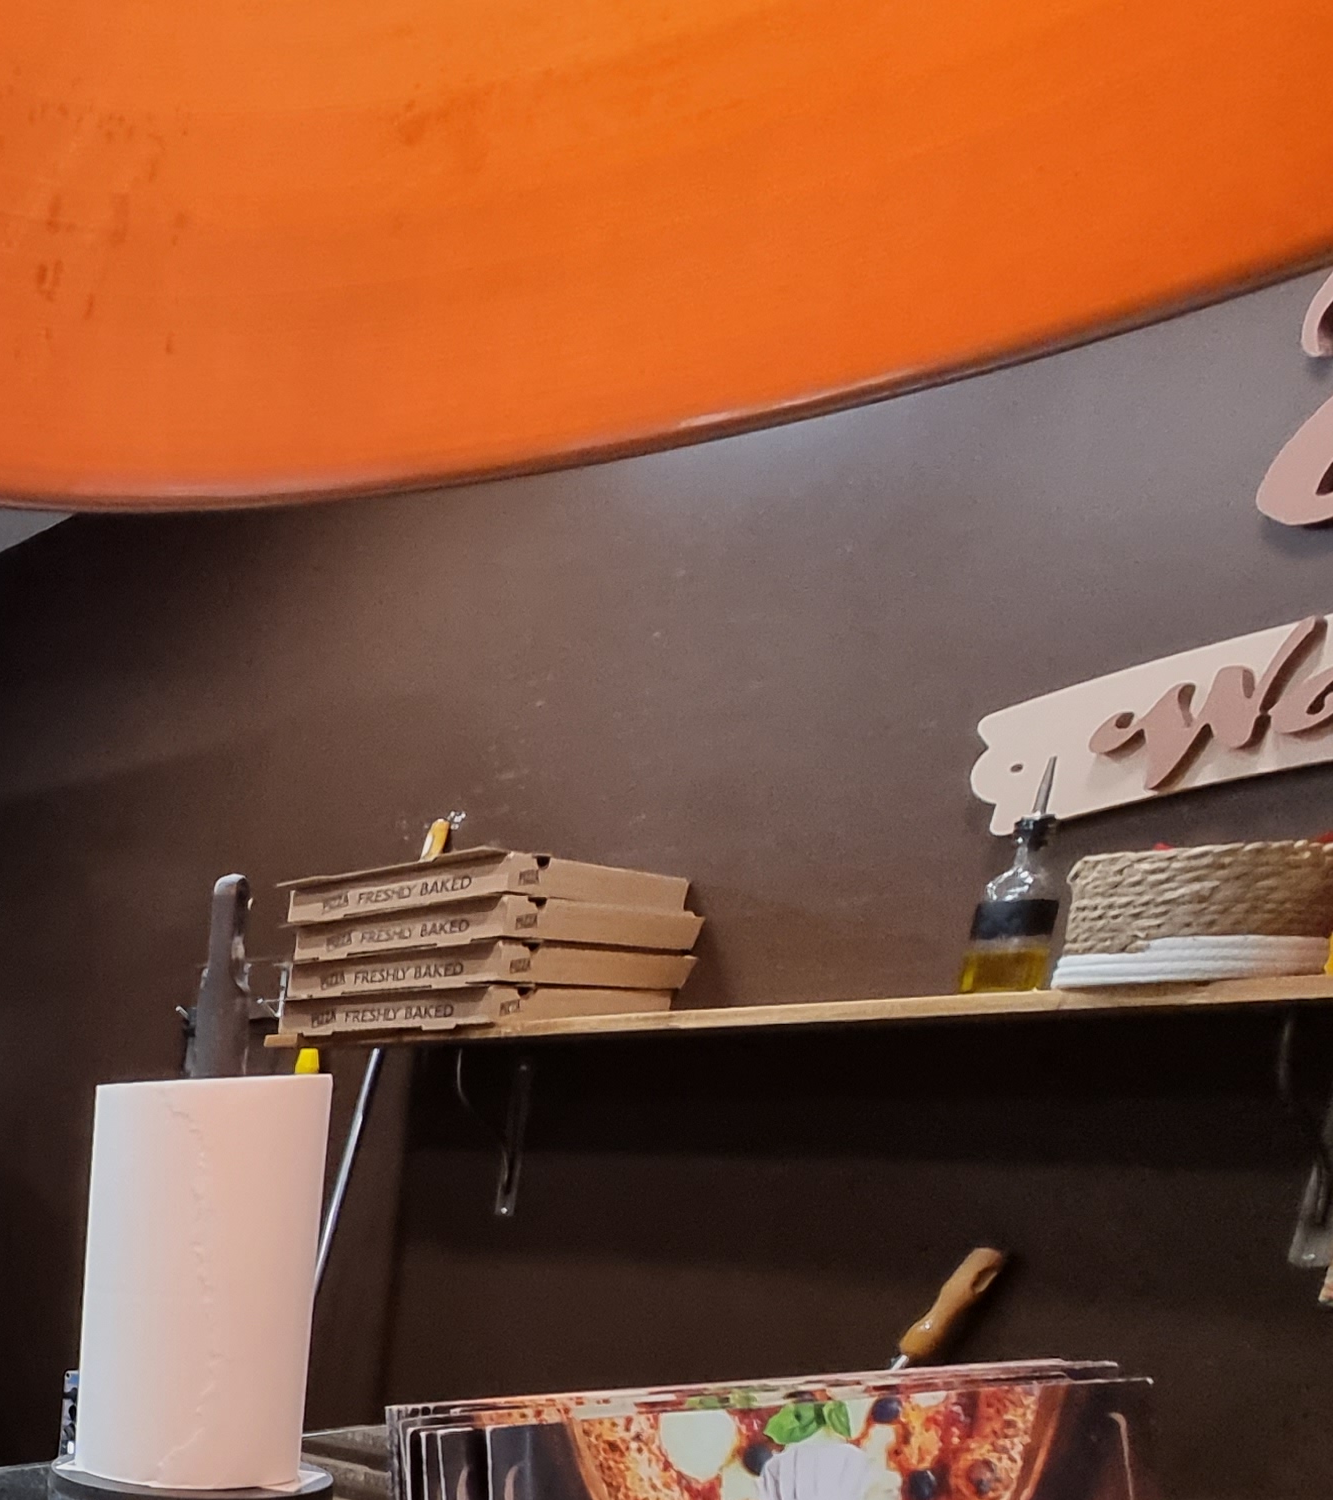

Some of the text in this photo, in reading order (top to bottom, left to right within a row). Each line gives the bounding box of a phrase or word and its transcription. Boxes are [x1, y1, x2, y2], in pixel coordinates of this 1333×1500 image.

[357, 884, 416, 905] FRESHLY
[419, 875, 473, 896] BAKED
[360, 924, 413, 944] FRESHLY
[419, 918, 470, 938] BAKED
[353, 966, 410, 985] FRESHLY
[414, 961, 464, 980] BAKED
[509, 957, 531, 974] PIZZA
[344, 1006, 399, 1024] FRESHLY
[404, 1003, 454, 1020] BAKED
